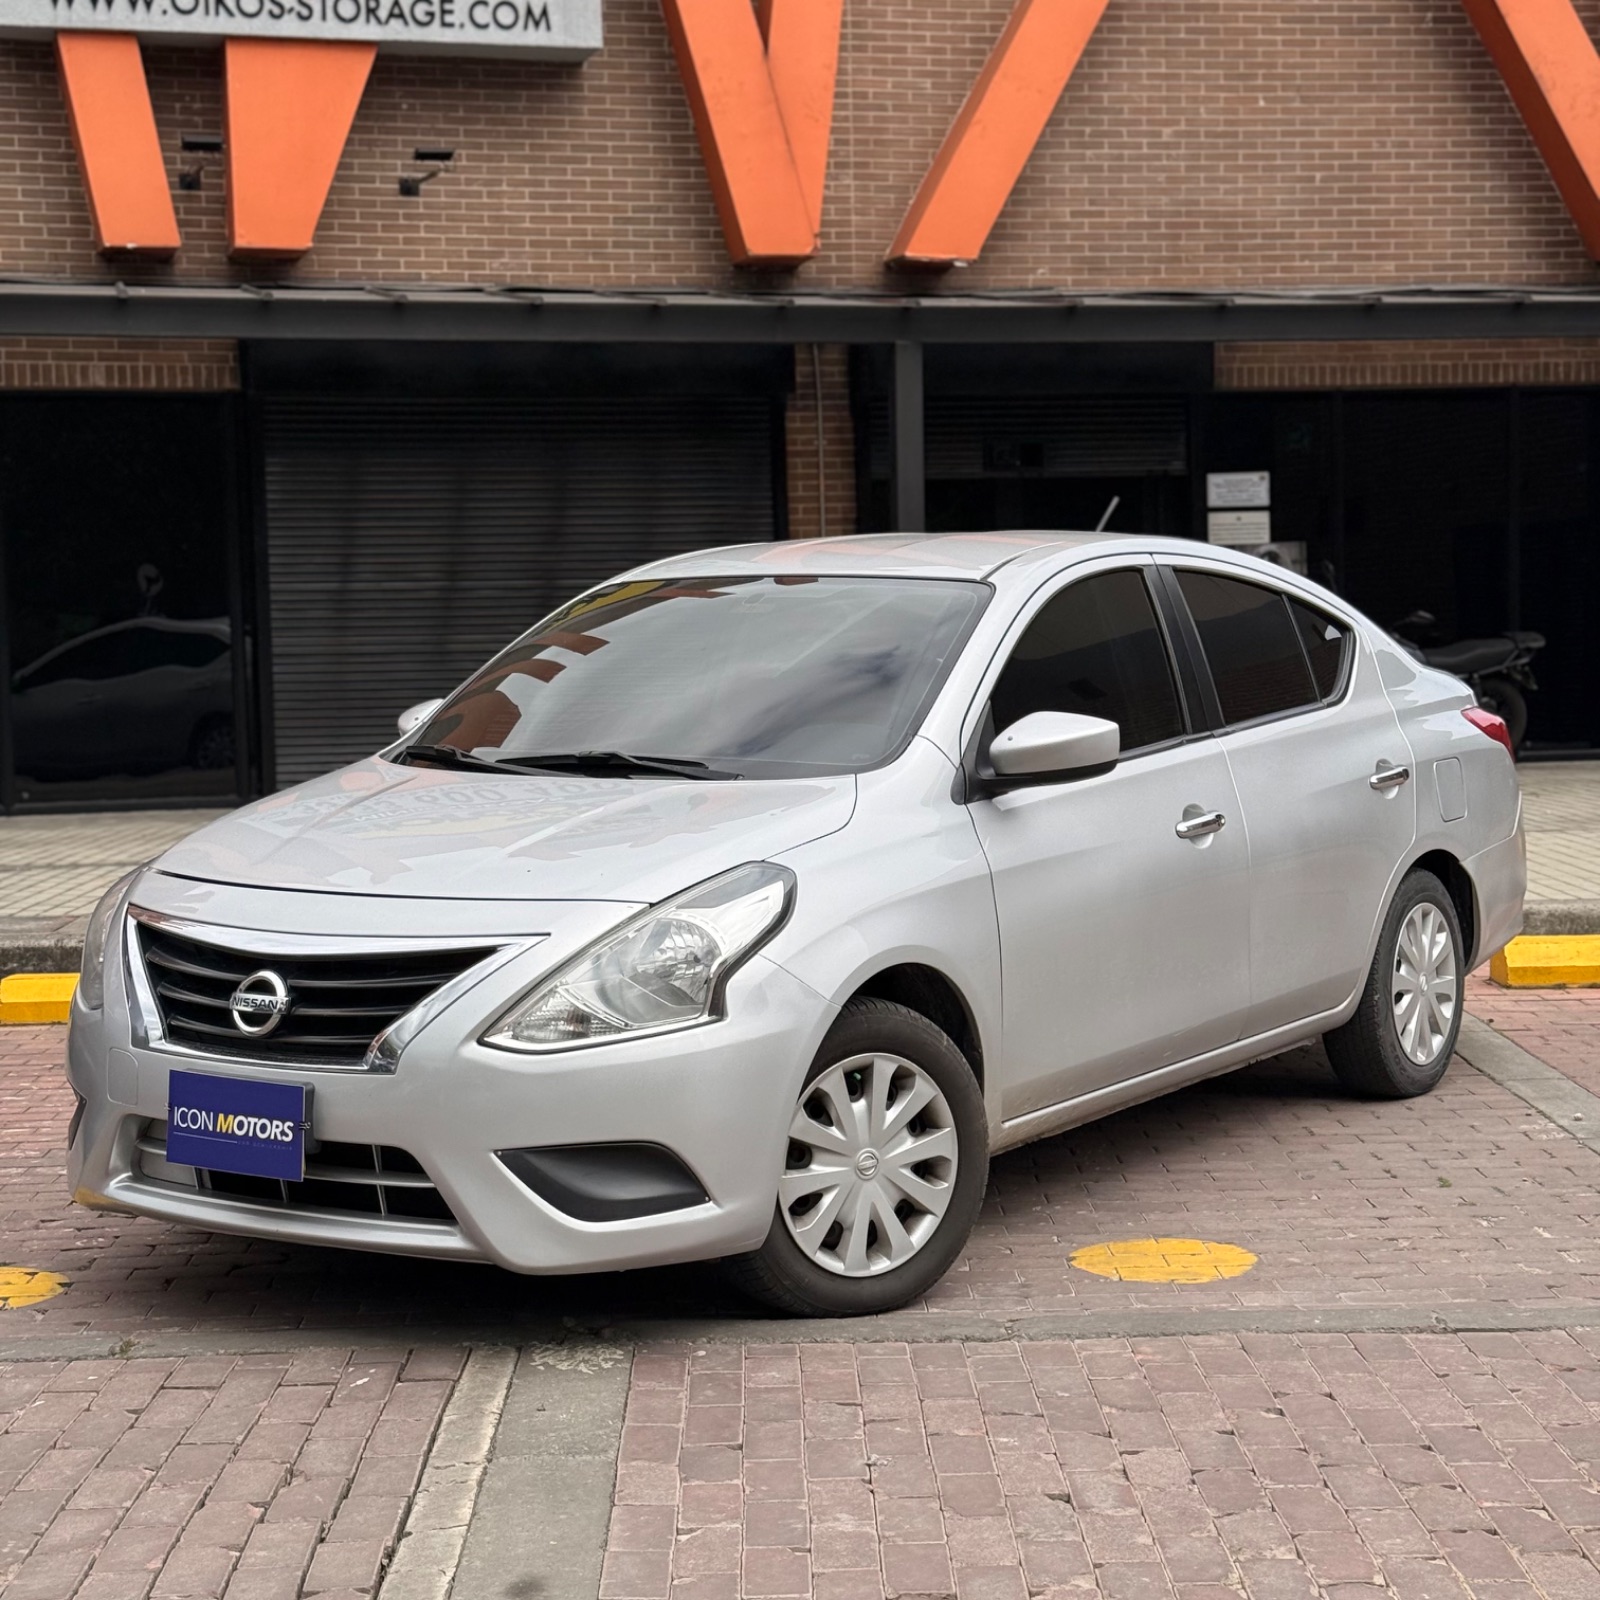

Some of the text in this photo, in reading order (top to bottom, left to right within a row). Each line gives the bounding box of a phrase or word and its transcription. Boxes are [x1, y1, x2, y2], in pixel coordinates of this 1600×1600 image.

[233, 997, 279, 1011] NISSAN
[173, 1106, 295, 1143] ICON MOTORS
